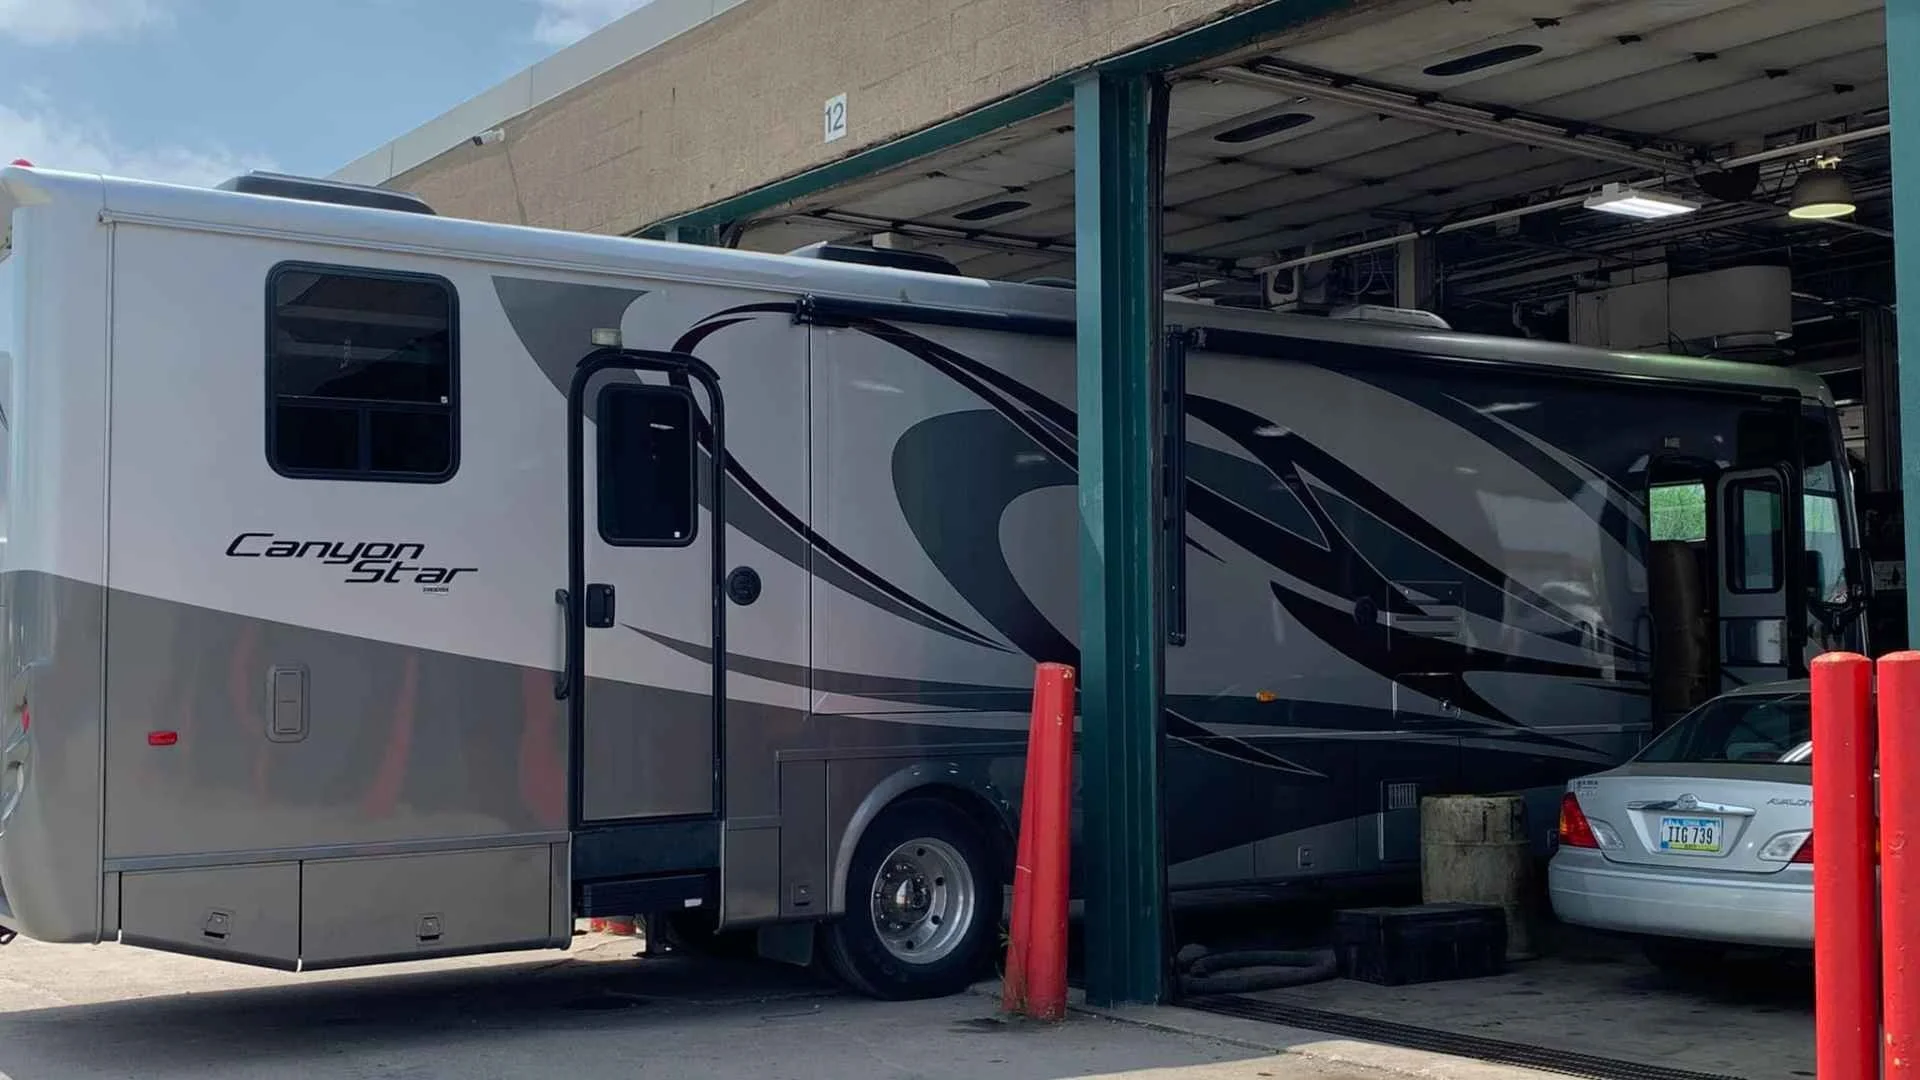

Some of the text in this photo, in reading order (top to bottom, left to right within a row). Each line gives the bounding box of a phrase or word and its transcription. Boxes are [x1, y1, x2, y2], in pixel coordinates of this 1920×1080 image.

[825, 102, 844, 133] 12
[225, 533, 425, 564] Canyon
[344, 560, 478, 583] Star
[1668, 826, 1713, 845] IIG 739
